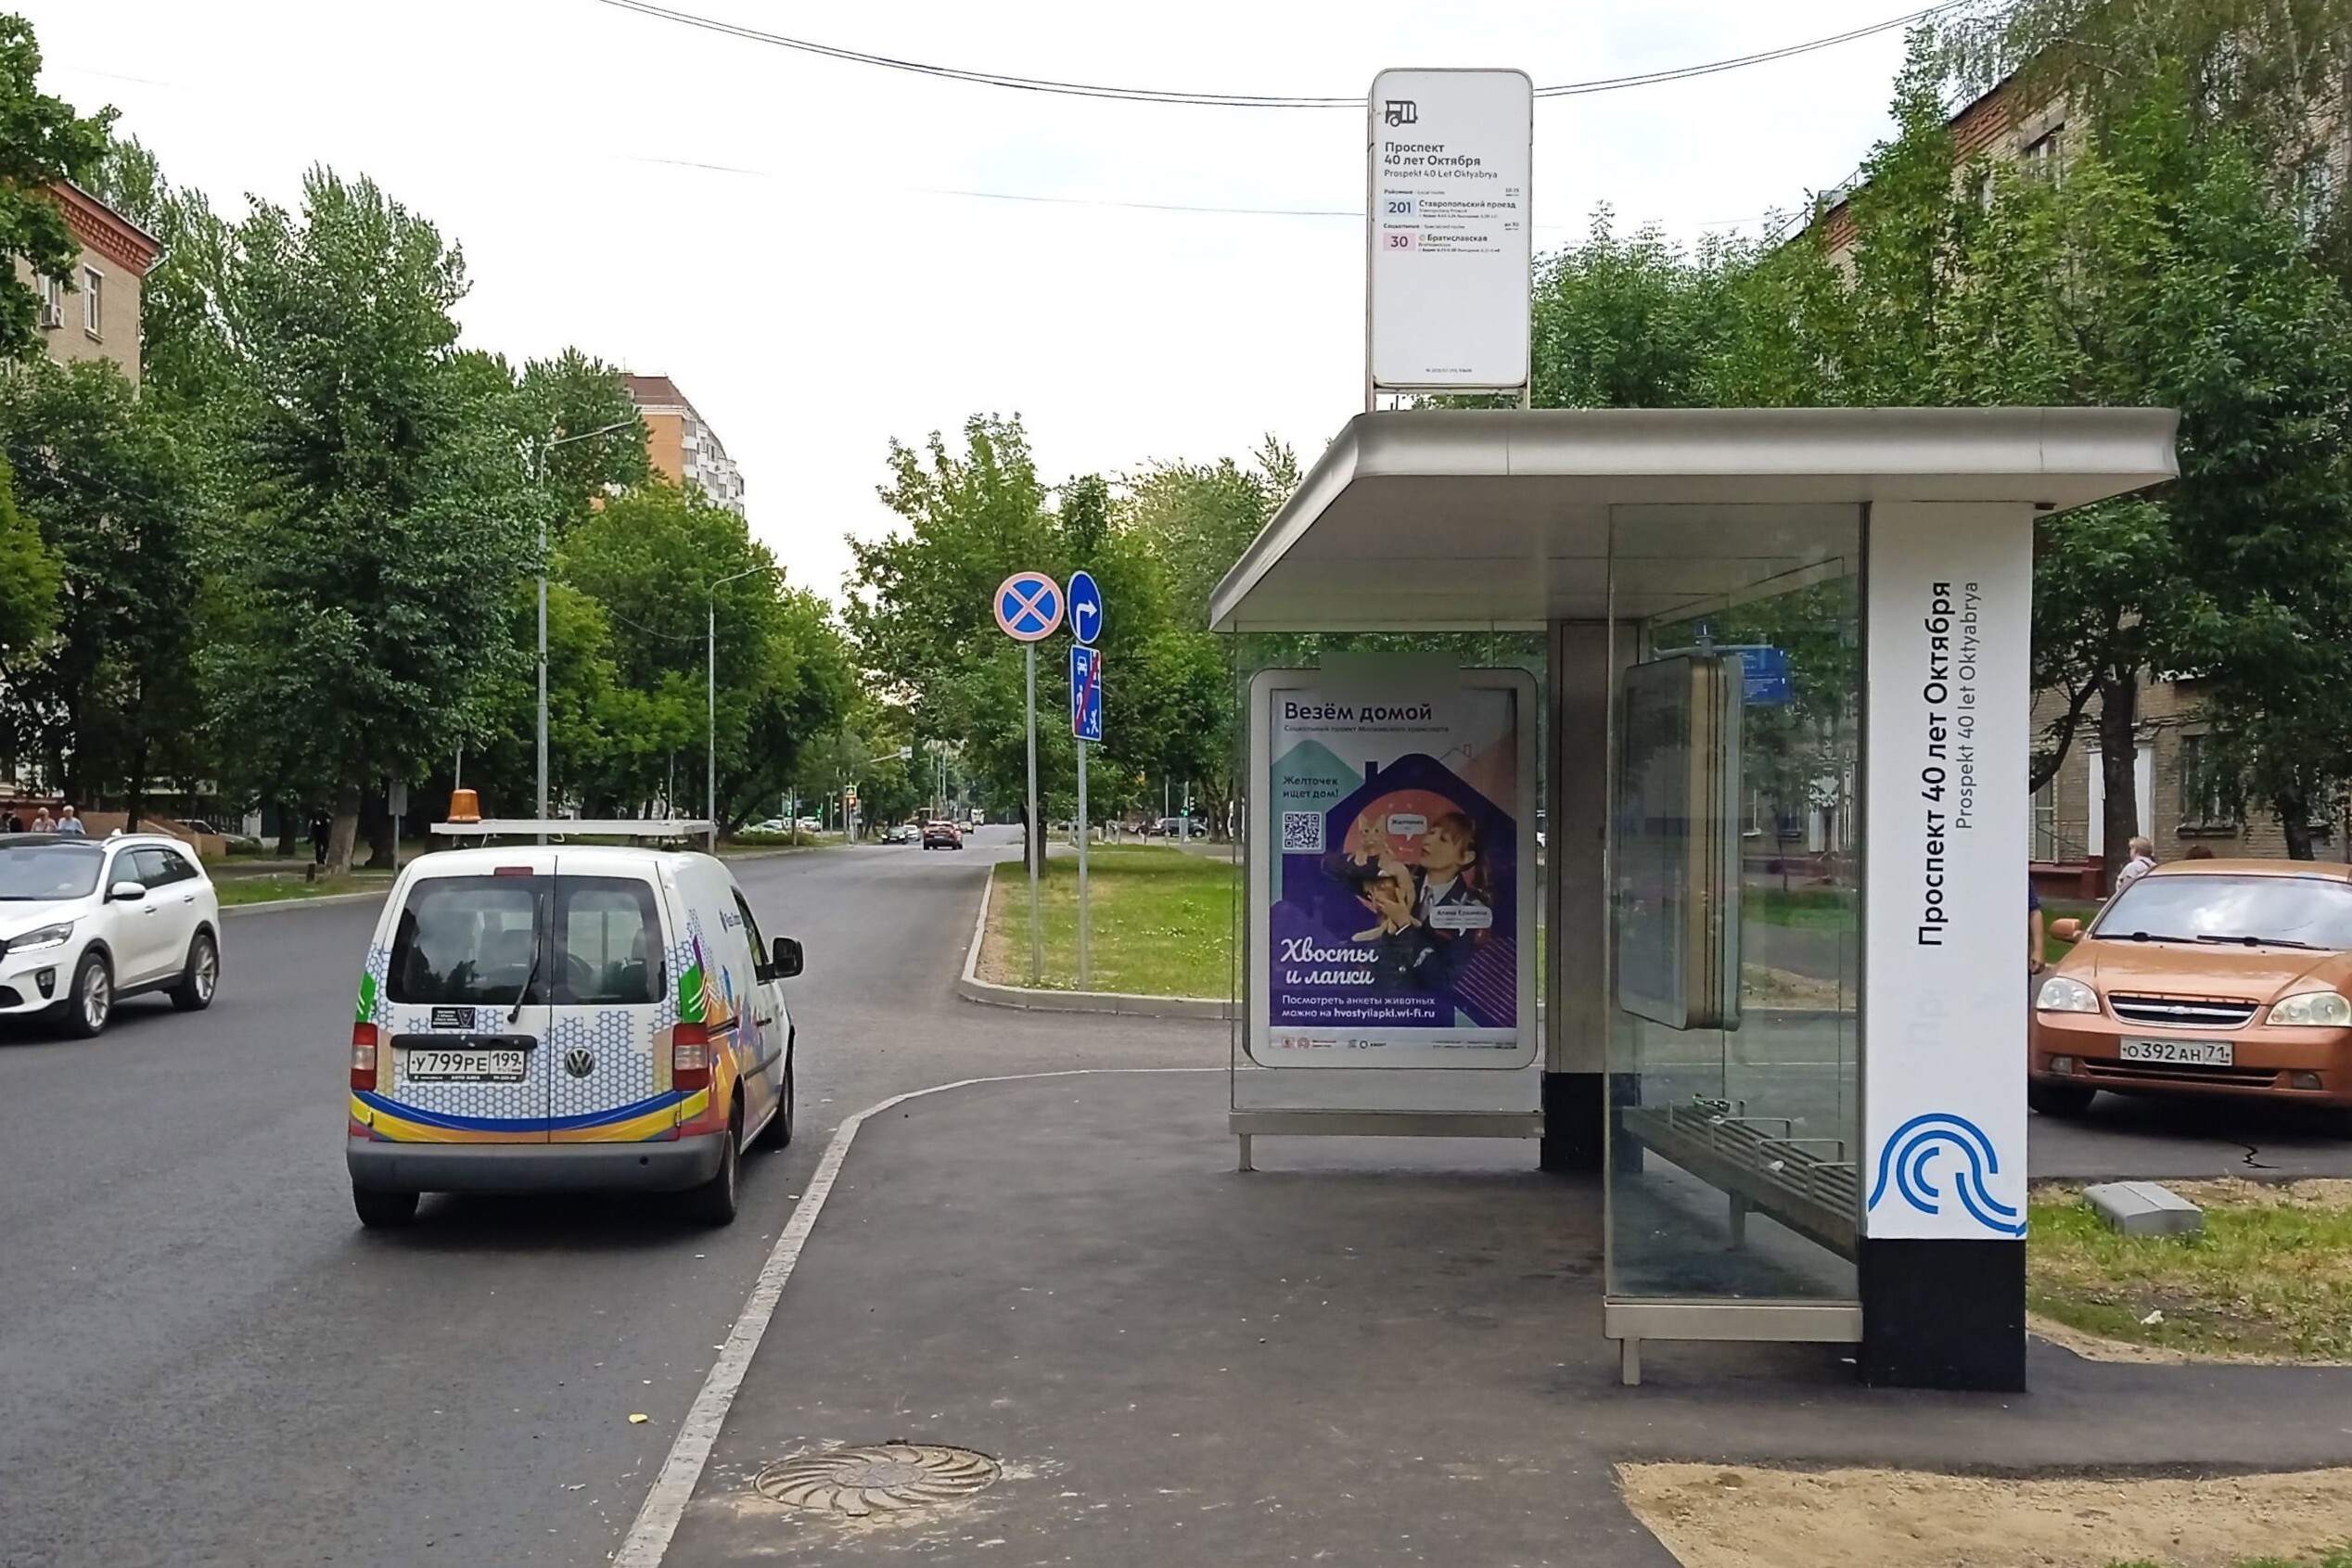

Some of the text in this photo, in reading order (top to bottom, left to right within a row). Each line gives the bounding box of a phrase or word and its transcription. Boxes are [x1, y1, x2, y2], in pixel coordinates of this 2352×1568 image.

[1385, 142, 1444, 154] Проспект
[1385, 155, 1481, 168] 40 лет Октября
[1384, 169, 1422, 179] Prospekt
[1438, 170, 1451, 178] Let
[1453, 170, 1498, 179] Oktyabrya
[1388, 201, 1411, 213] 201
[1390, 236, 1408, 248] 30
[1955, 582, 1982, 829] Prospekt 40 let Oktyabrya
[1285, 702, 1432, 723] Везём домой
[1918, 582, 1955, 945] Проспект 40 лет Октября
[1283, 776, 1338, 785] Желточек
[1312, 788, 1338, 798] дом!
[1280, 936, 1380, 962] Хвосты
[1285, 970, 1375, 985] и лапки
[1282, 994, 1435, 1006] Посмотреть анкеты животных
[1334, 1007, 1436, 1019] hvostyilapki.wi-fi.ru
[2206, 1045, 2224, 1058] 71
[492, 1052, 519, 1066] 199
